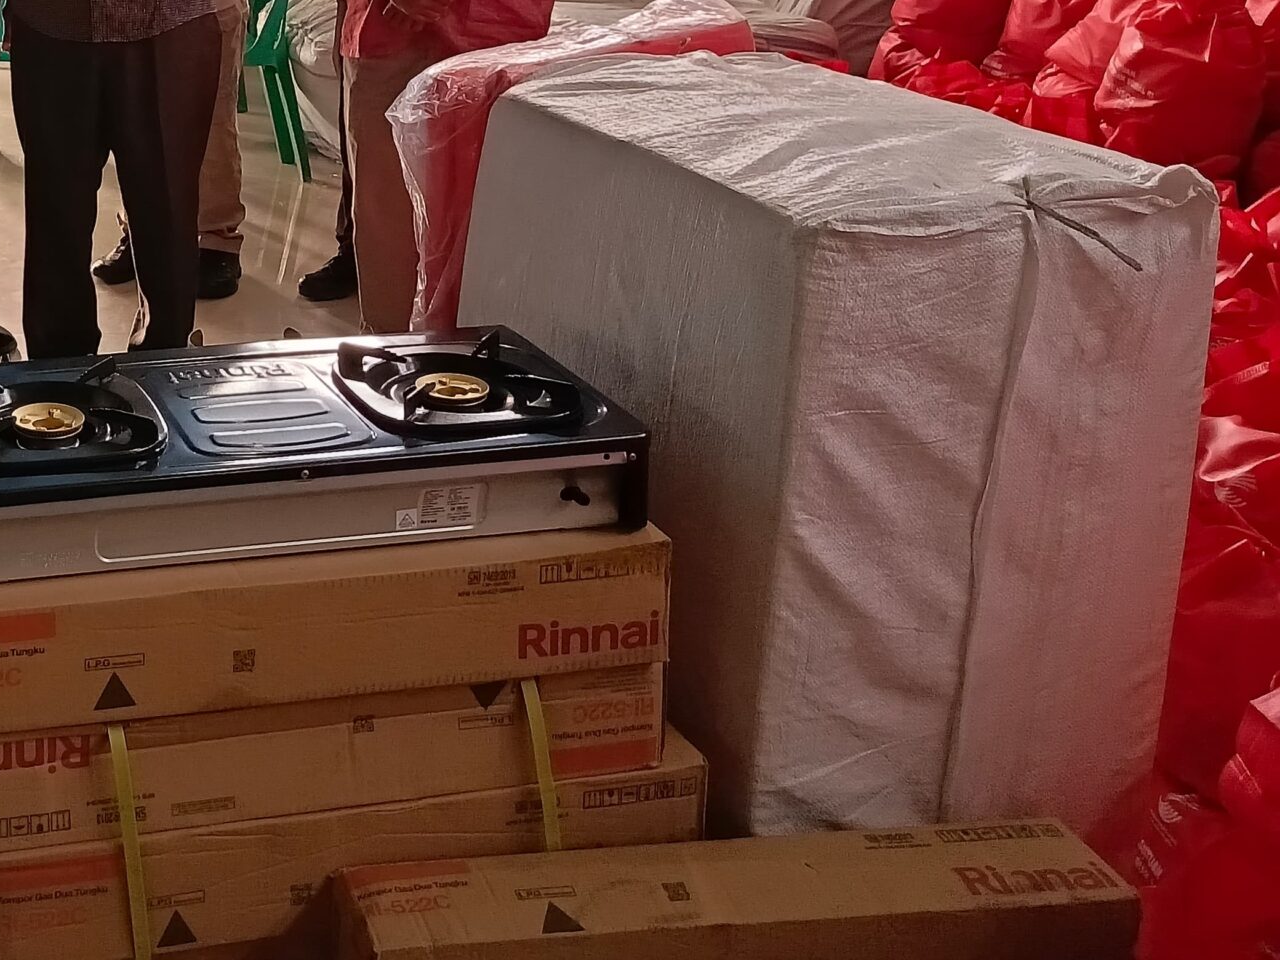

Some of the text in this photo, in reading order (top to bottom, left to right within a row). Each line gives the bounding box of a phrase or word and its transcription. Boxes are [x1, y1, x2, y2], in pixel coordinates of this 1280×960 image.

[517, 608, 660, 660] Rinnai
[10, 645, 45, 658] Tungku
[950, 860, 1120, 896] Rinnai
[73, 885, 109, 899] Tungku
